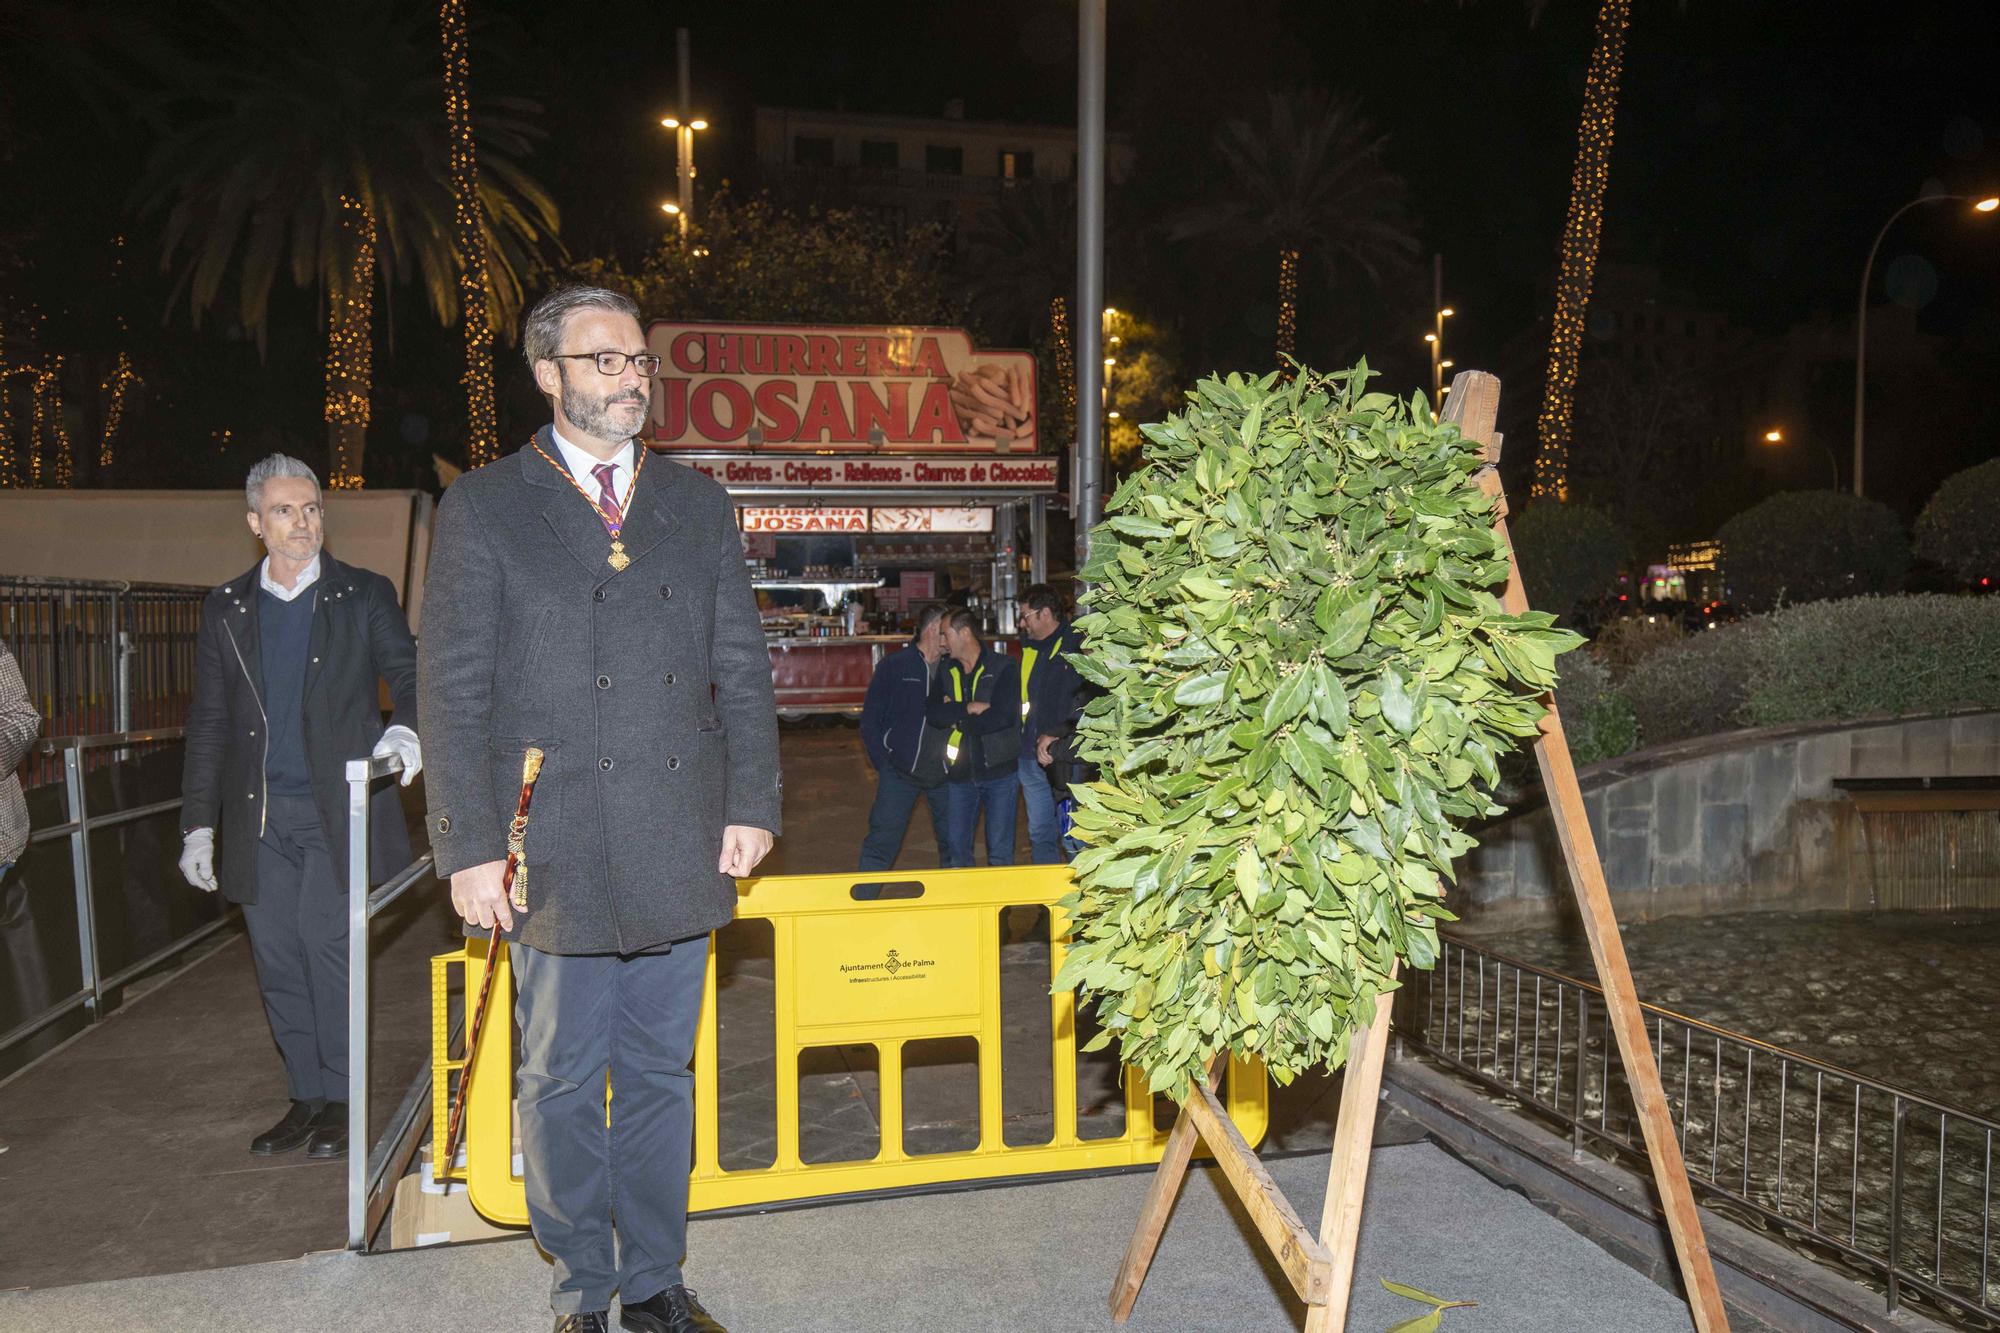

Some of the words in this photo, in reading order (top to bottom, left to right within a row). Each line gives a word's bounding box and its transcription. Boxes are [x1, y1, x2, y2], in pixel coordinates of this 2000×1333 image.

[671, 331, 951, 377] CHURRERIA
[652, 377, 968, 443] JOSANA
[726, 462, 772, 482] Gofres
[844, 462, 903, 482] Rellenos
[914, 462, 967, 482] Churros
[970, 462, 986, 482] de
[746, 517, 865, 530] JOSANA
[840, 963, 884, 973] Ajuntament
